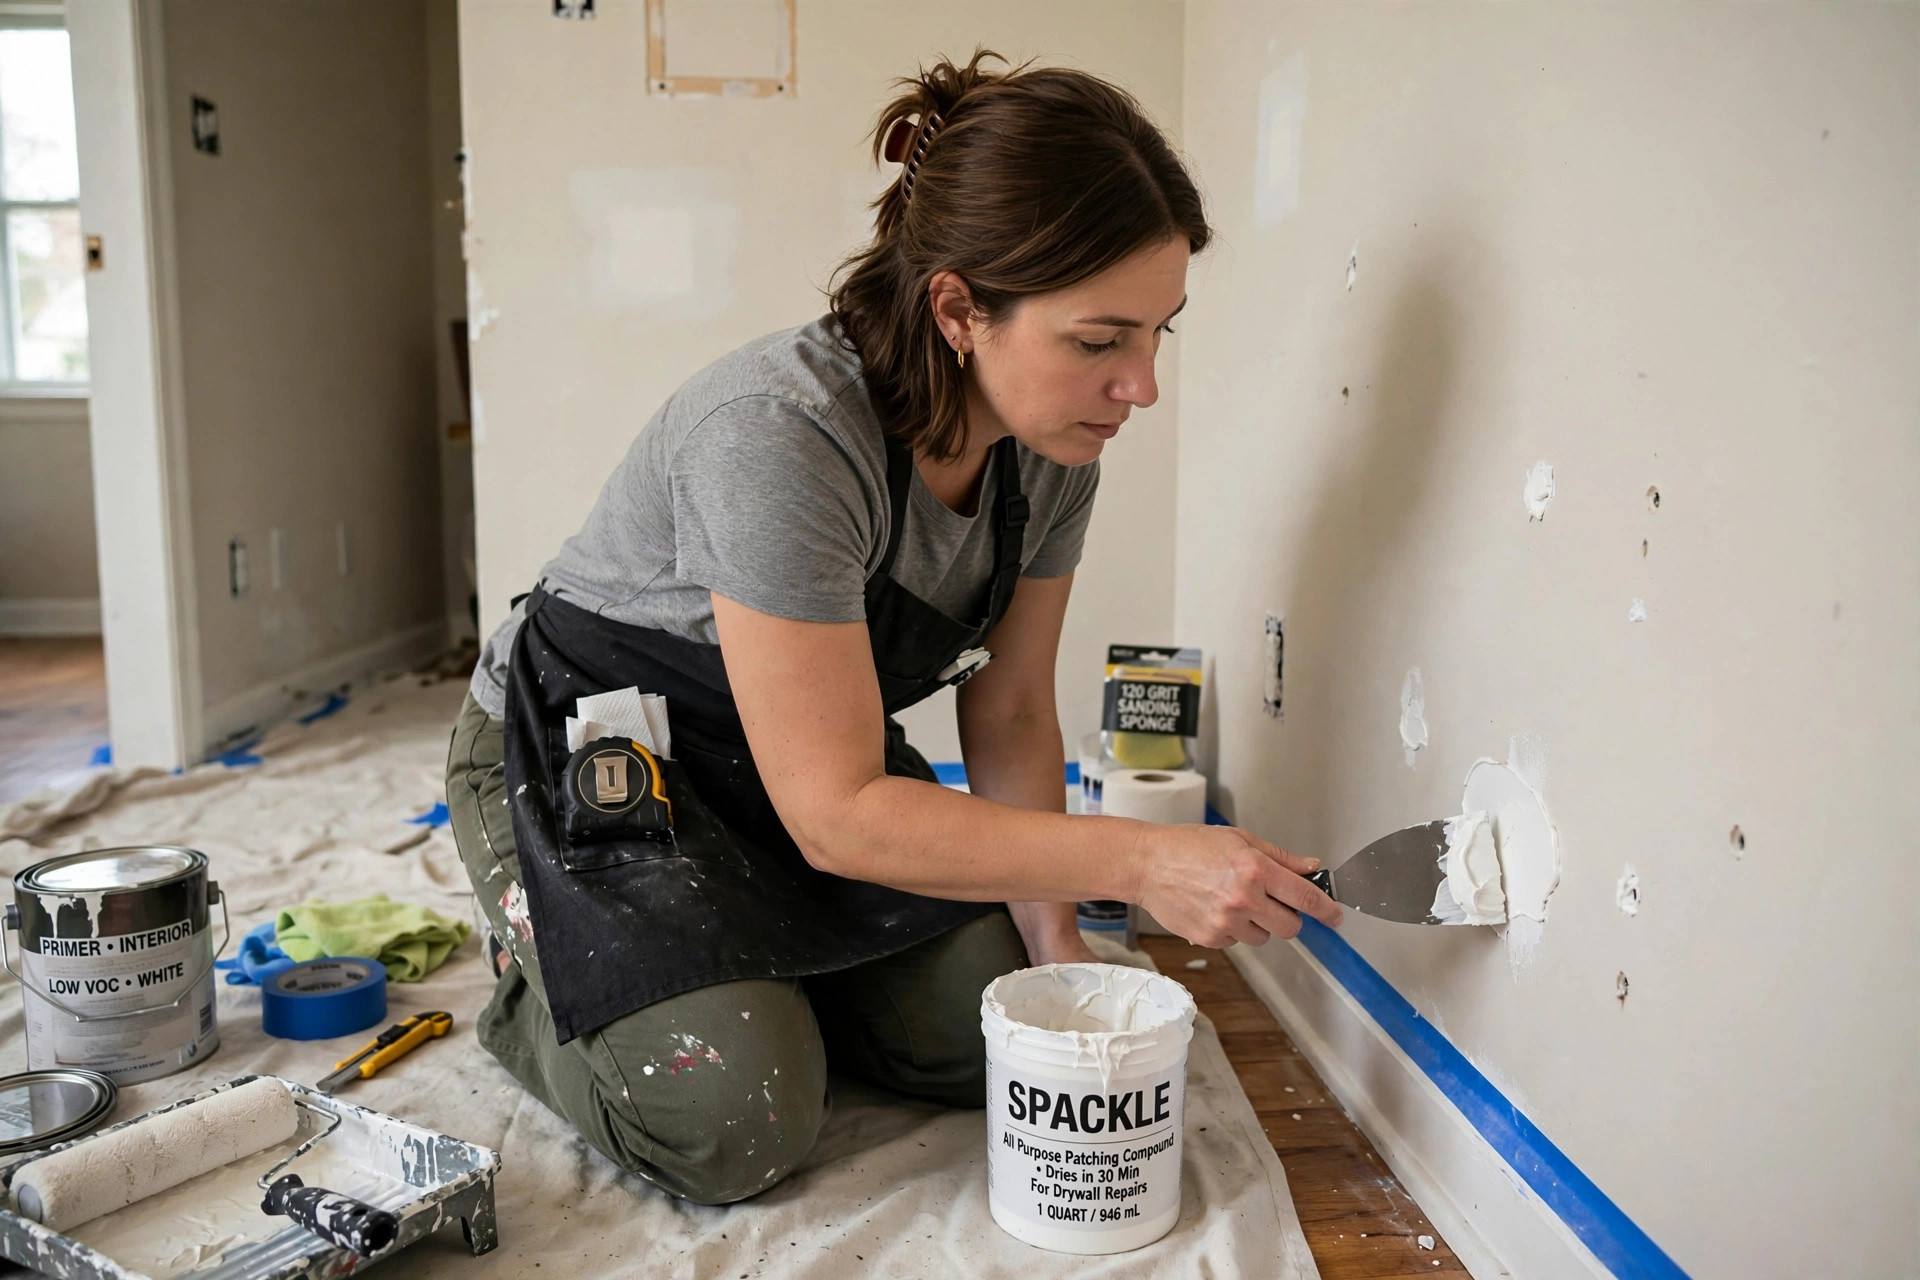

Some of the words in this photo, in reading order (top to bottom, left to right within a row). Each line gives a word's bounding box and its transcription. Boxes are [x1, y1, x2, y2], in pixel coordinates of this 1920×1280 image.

[1121, 684, 1145, 699] 120
[1147, 685, 1180, 700] GRIT
[1118, 699, 1180, 717] SANDING
[1120, 715, 1176, 732] SPONGE
[42, 940, 101, 957] PRIMER
[120, 922, 191, 953] INTERIOR
[49, 978, 80, 995] LOW
[85, 978, 119, 995] VOC
[137, 962, 184, 988] WHITE
[1008, 1080, 1170, 1133] SPACKLE
[1003, 1131, 1014, 1149] All
[1017, 1138, 1061, 1164] Purpose
[1065, 1151, 1118, 1167] Patching
[1123, 1133, 1174, 1162] Compound
[1046, 1166, 1077, 1183] Dries
[1082, 1170, 1093, 1183] in
[1098, 1169, 1114, 1183] 30
[1118, 1165, 1140, 1181] Min
[1031, 1178, 1049, 1195] For
[1053, 1184, 1100, 1202] Drywall
[1105, 1182, 1147, 1202] Repairs
[1037, 1202, 1043, 1216] 1
[1047, 1206, 1087, 1222] QUART
[1090, 1208, 1096, 1222] /
[1099, 1207, 1121, 1221] 946
[1125, 1203, 1140, 1218] mL
